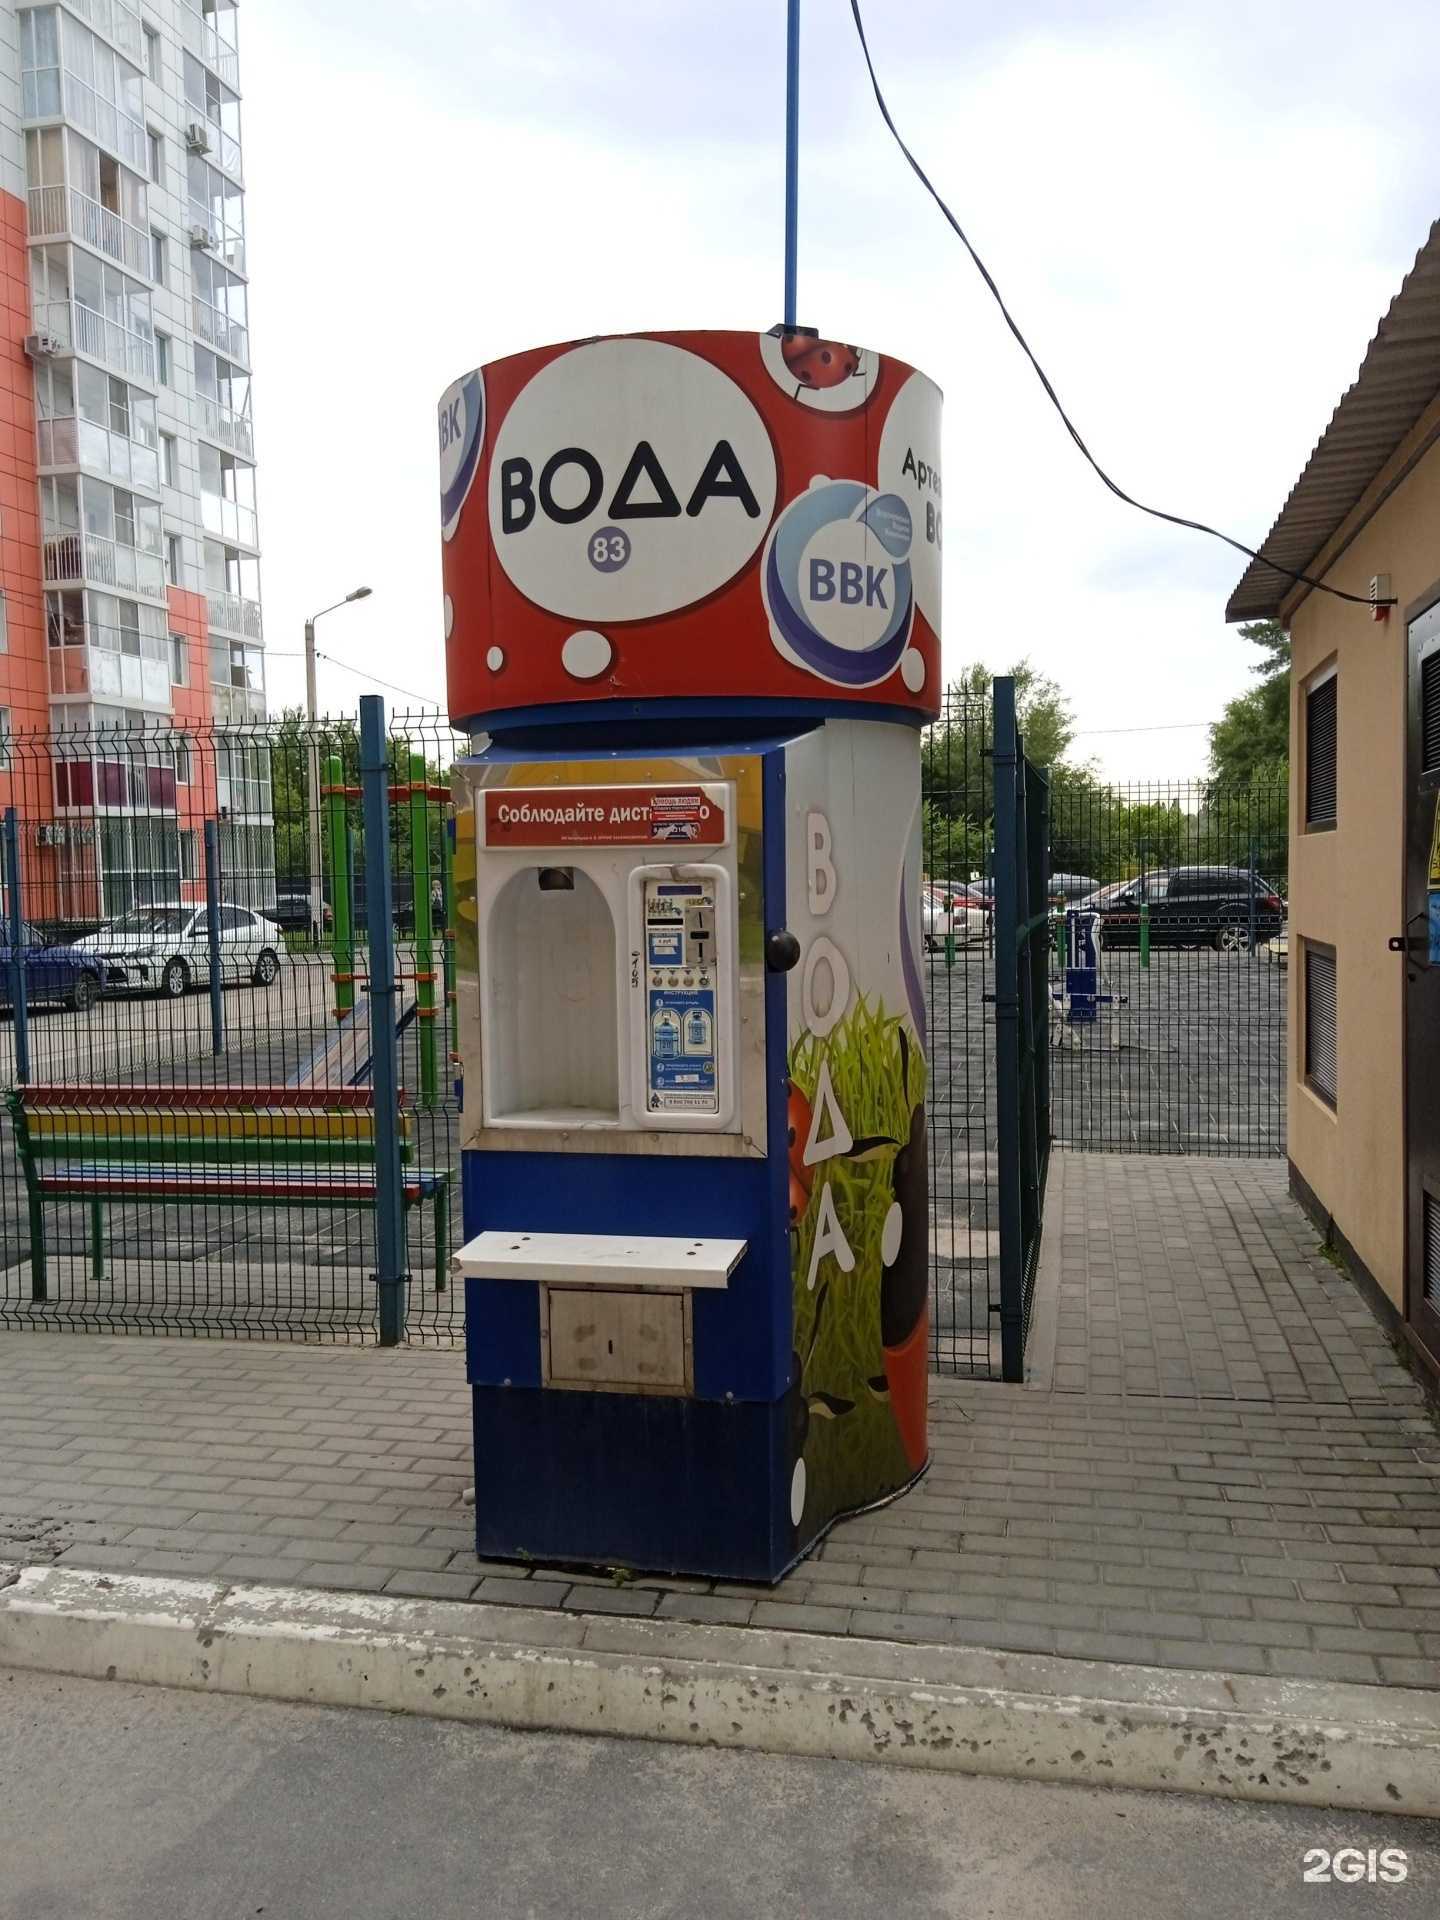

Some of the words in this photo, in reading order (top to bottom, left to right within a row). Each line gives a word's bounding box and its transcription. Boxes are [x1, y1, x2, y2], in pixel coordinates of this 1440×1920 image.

[502, 439, 761, 535] ВОДА
[592, 536, 627, 563] 83
[808, 557, 889, 610] ВВК
[497, 802, 605, 825] Соблюдайте
